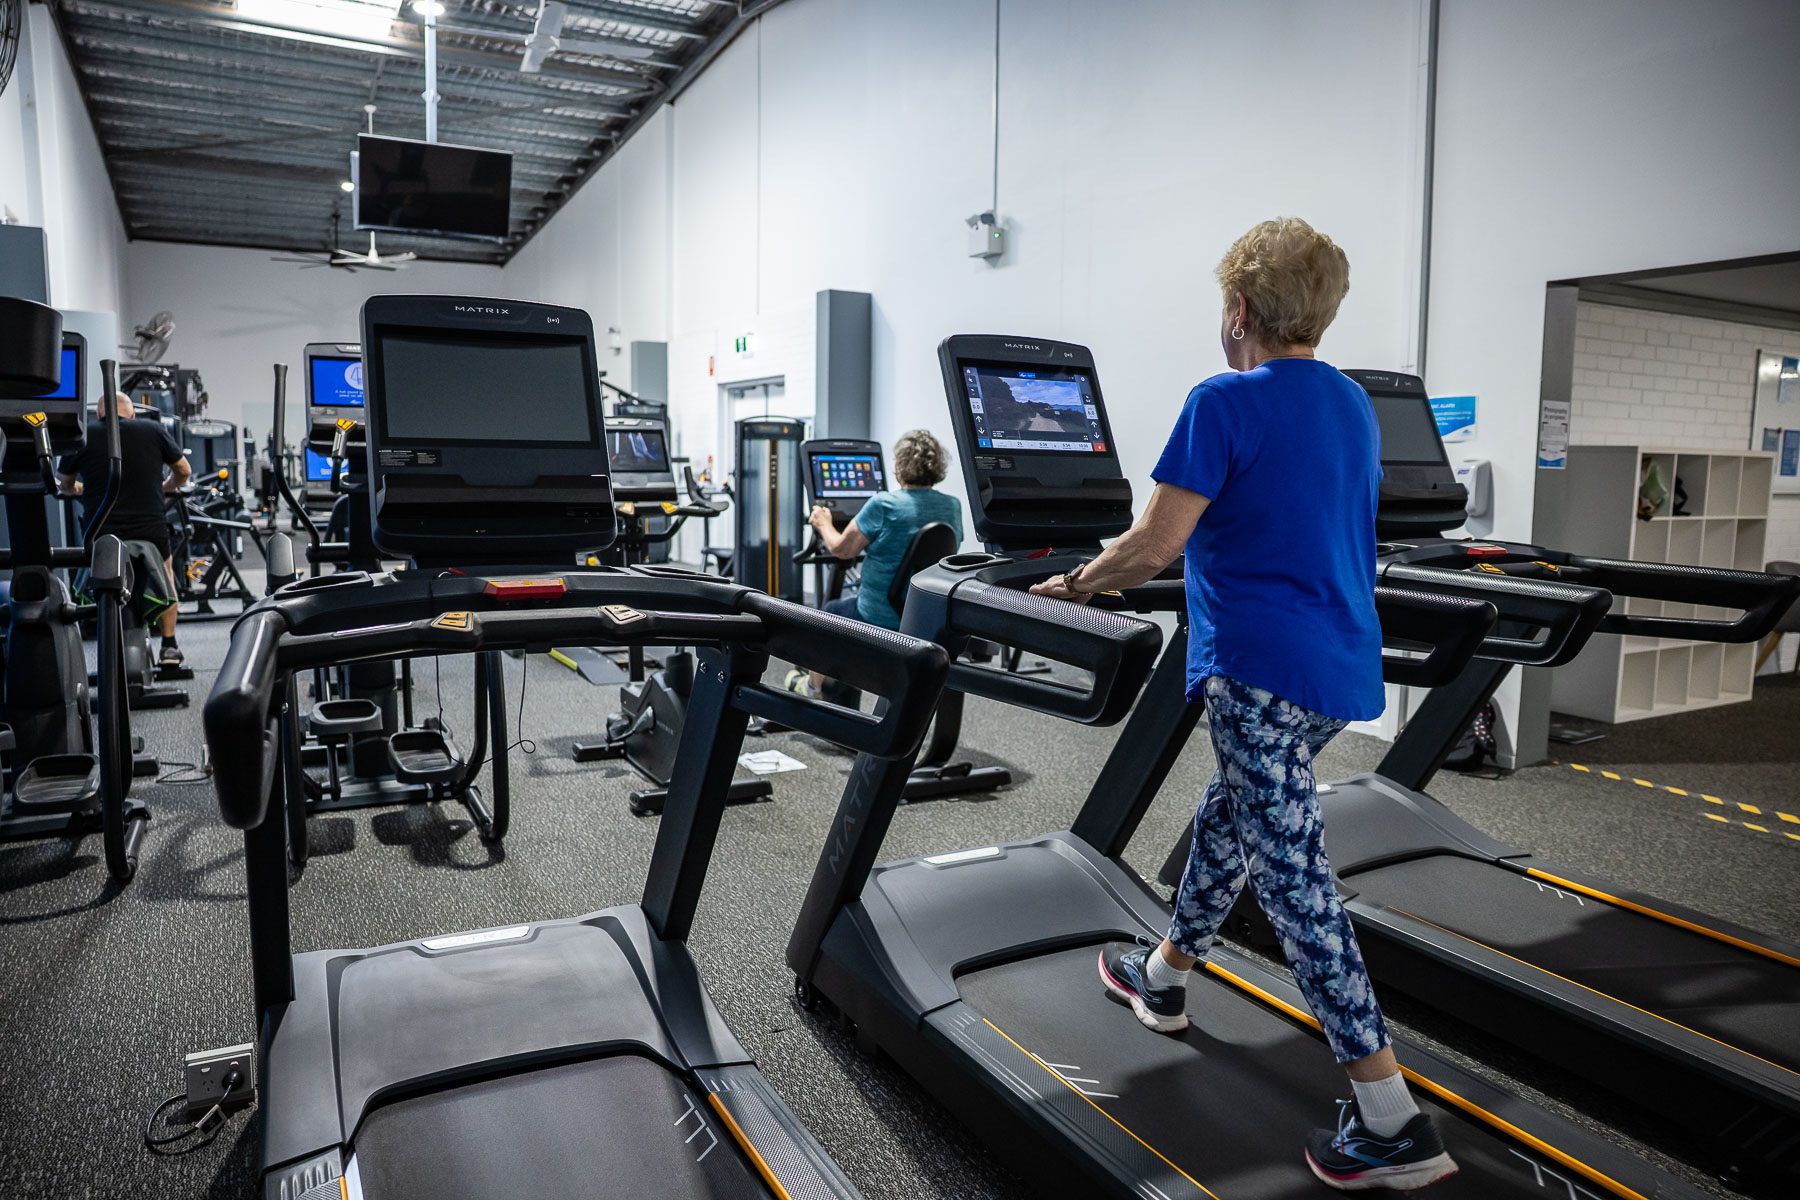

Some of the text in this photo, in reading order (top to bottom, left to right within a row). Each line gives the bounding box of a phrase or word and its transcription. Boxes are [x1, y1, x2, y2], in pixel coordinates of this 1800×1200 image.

[454, 305, 510, 315] MATRIX
[1004, 343, 1041, 351] MATRIX
[829, 754, 877, 874] MATR
